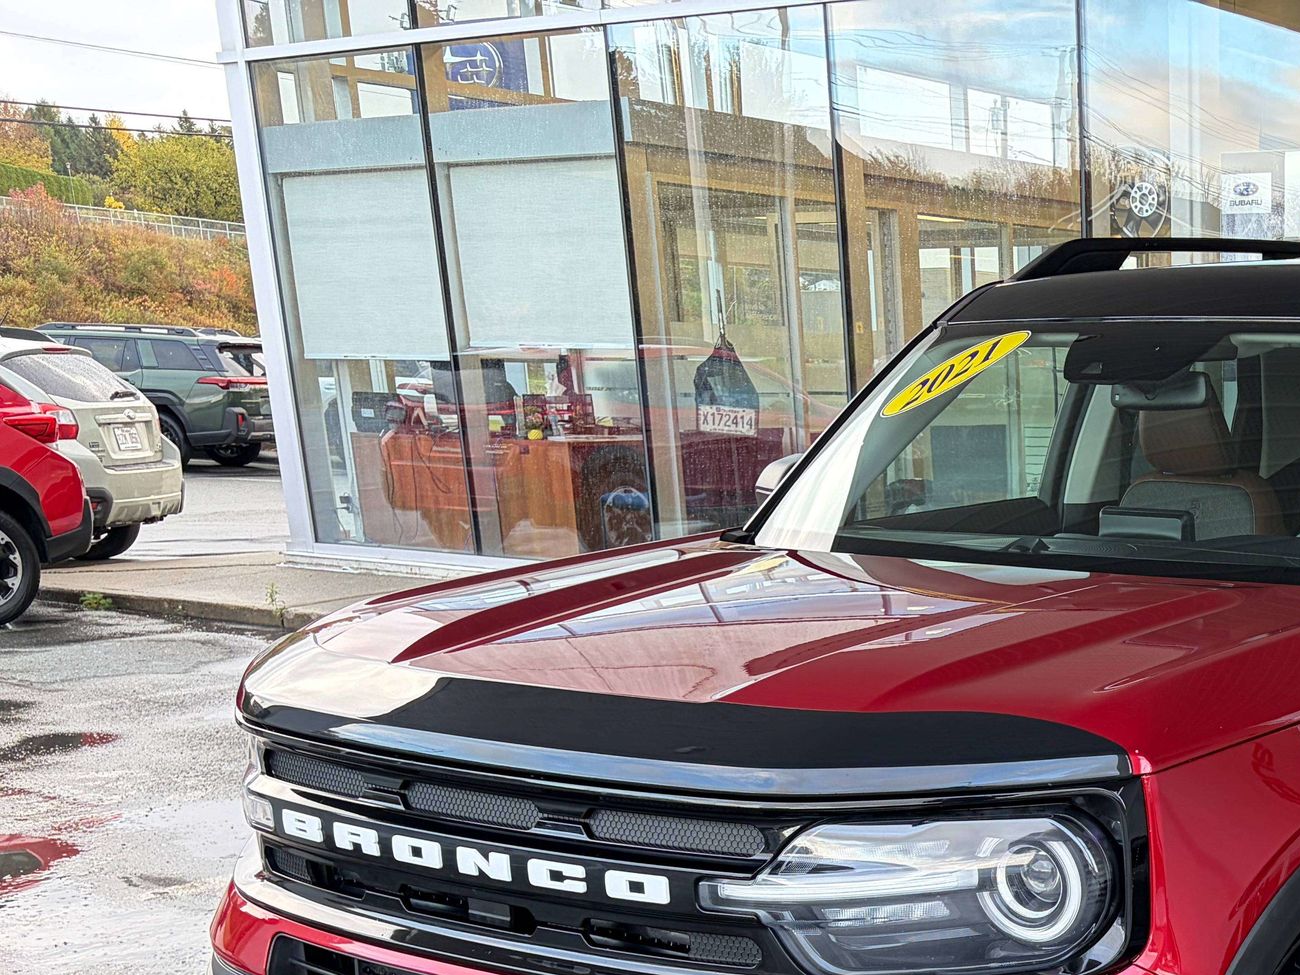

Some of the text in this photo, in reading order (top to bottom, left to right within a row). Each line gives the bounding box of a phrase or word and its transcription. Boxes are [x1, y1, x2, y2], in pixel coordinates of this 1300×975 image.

[1229, 199, 1263, 207] SUBARU
[898, 338, 1003, 411] 2021
[702, 411, 753, 430] X172414
[281, 808, 671, 905] BRONCO
